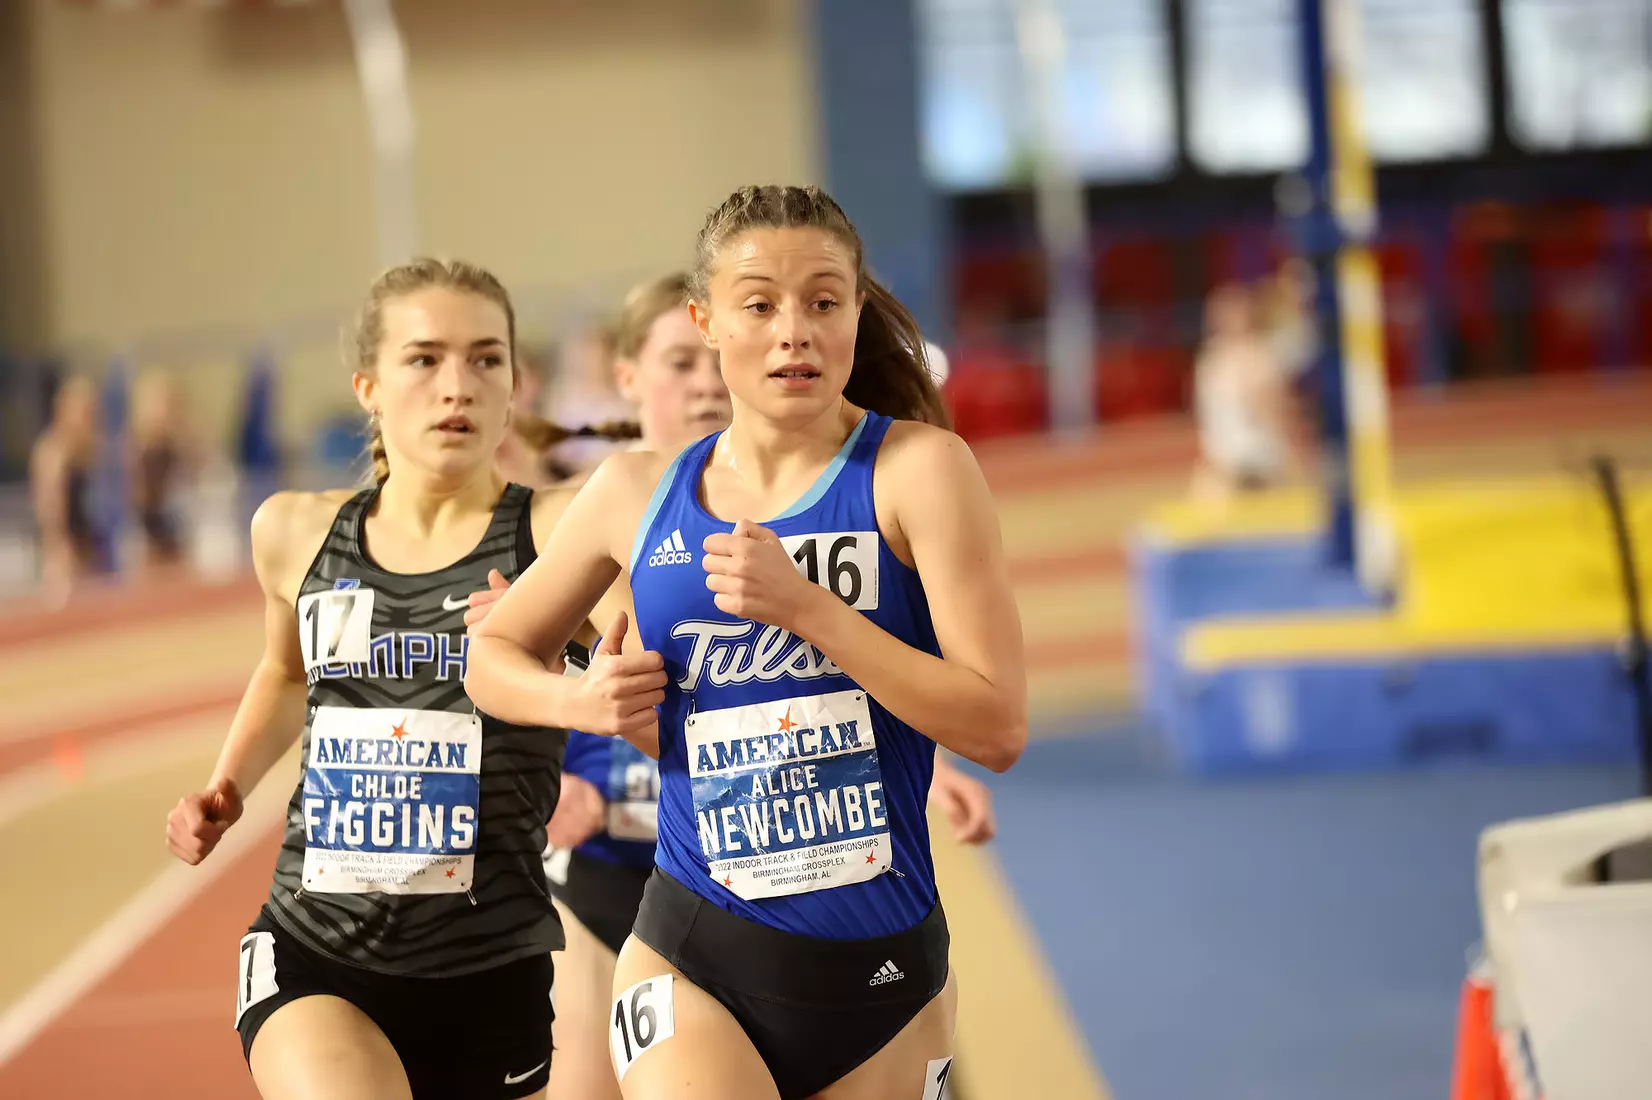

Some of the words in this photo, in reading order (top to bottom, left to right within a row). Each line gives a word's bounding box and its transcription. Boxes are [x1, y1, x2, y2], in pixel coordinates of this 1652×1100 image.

[649, 550, 692, 567] adidas
[793, 536, 862, 606] 16
[306, 595, 356, 661] 17
[316, 738, 467, 768] AMERICAN
[697, 720, 862, 772] AMERICAN
[351, 774, 422, 800] CHLOE
[751, 764, 819, 797] ALICE
[304, 798, 475, 850] FIGGINS
[697, 781, 886, 856] NEWCOMBE
[732, 858, 762, 870] INDOOR
[763, 853, 789, 866] TRACK
[790, 852, 796, 862] &
[819, 838, 879, 857] CHAMPIONSHIPS
[752, 864, 801, 879] BIRMINGHAM
[801, 856, 846, 872] CROSSPLEX
[770, 873, 820, 887] BIRMINGHAM,
[821, 870, 831, 879] AL
[869, 970, 905, 986] adidas
[615, 982, 657, 1063] 16
